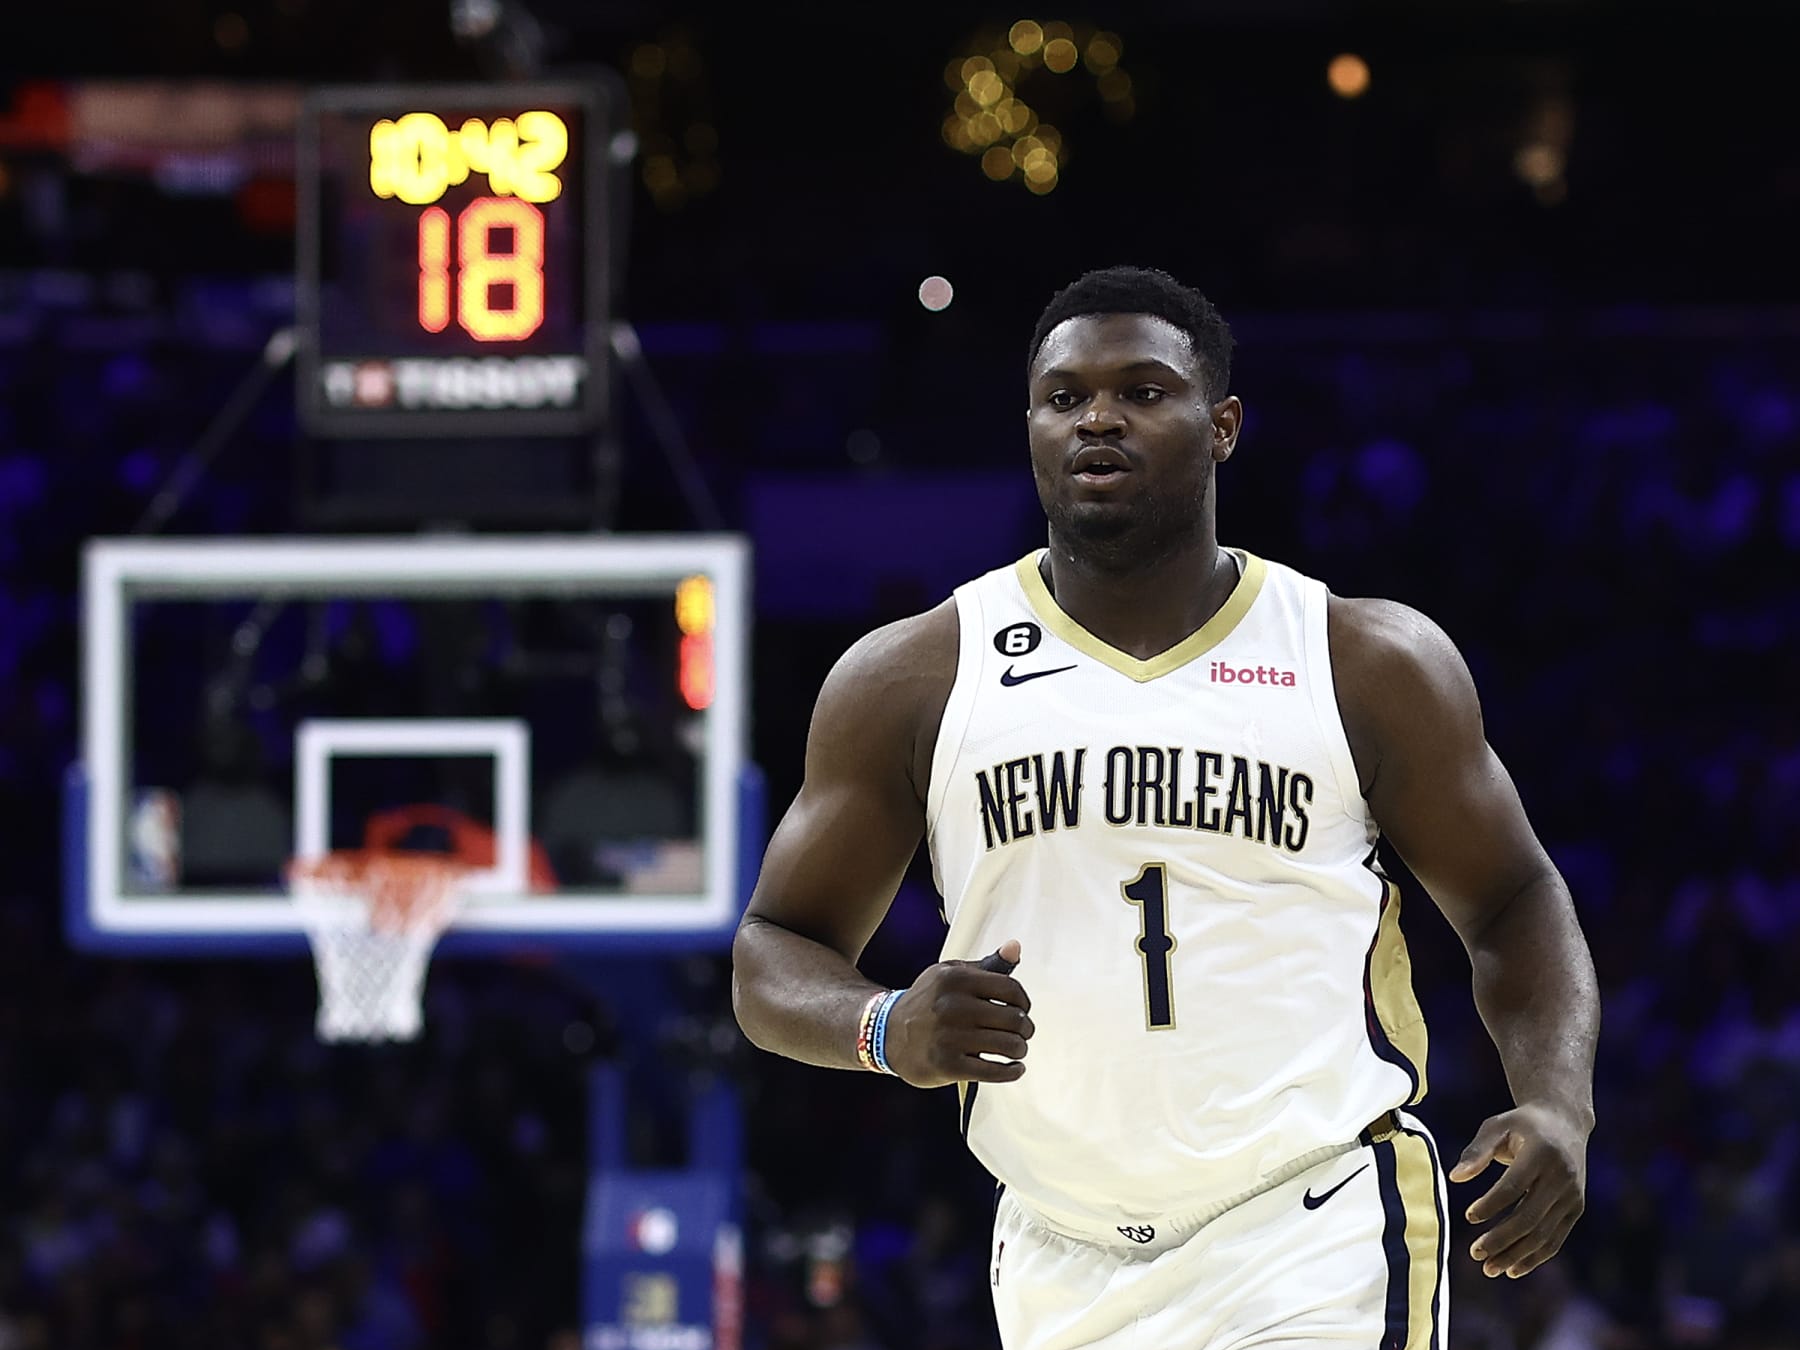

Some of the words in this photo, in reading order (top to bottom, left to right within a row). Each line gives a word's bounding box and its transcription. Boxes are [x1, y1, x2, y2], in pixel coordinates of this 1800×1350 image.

[418, 196, 544, 342] 18
[1005, 627, 1031, 653] 6
[1211, 662, 1296, 687] ibotta
[975, 746, 1088, 852] NEW
[1102, 745, 1314, 854] ORLEANS
[1120, 861, 1177, 1032] 1
